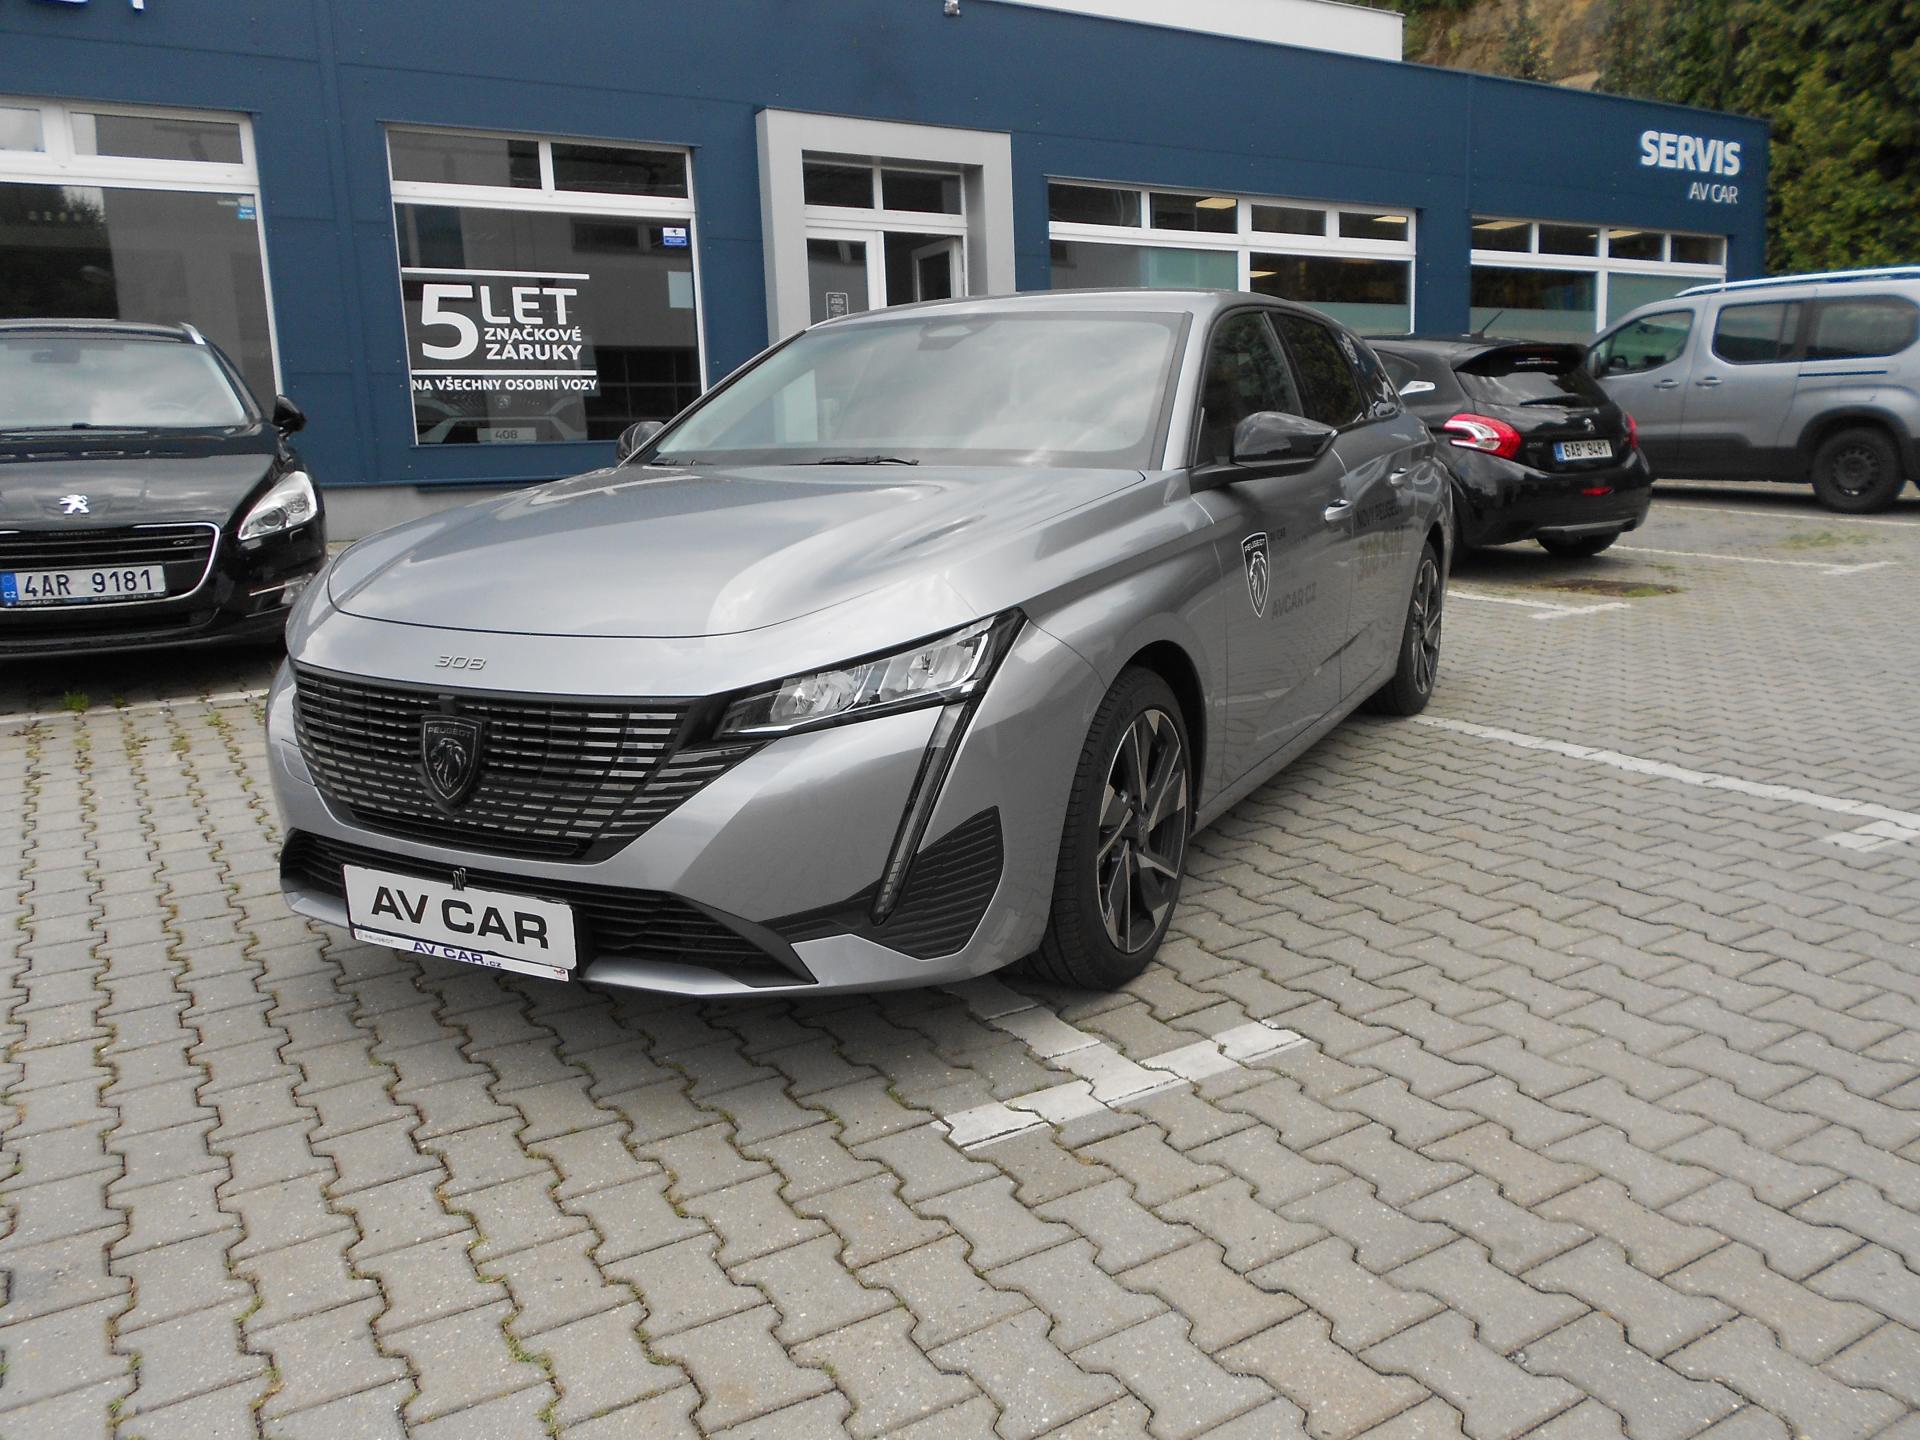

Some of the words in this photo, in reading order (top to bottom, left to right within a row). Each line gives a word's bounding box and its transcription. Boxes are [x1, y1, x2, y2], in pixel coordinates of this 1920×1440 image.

[1641, 130, 1741, 176] SERVIS
[1689, 182, 1710, 201] AV
[1711, 184, 1738, 204] CAR
[421, 283, 479, 361] 5
[480, 285, 577, 325] LET
[484, 325, 583, 342] ZNAČKOVÉ
[486, 340, 583, 361] ZÁRUKY
[413, 379, 434, 391] NA
[435, 376, 502, 391] VŠECHNY
[505, 376, 559, 391] OSOBNÍ
[561, 379, 598, 391] VOZY
[495, 430, 518, 440] 408
[25, 573, 71, 597] 4AR
[91, 569, 153, 593] 9181
[434, 654, 487, 671] 308
[371, 885, 429, 924] AV
[441, 898, 549, 949] CAR
[413, 941, 436, 955] AV
